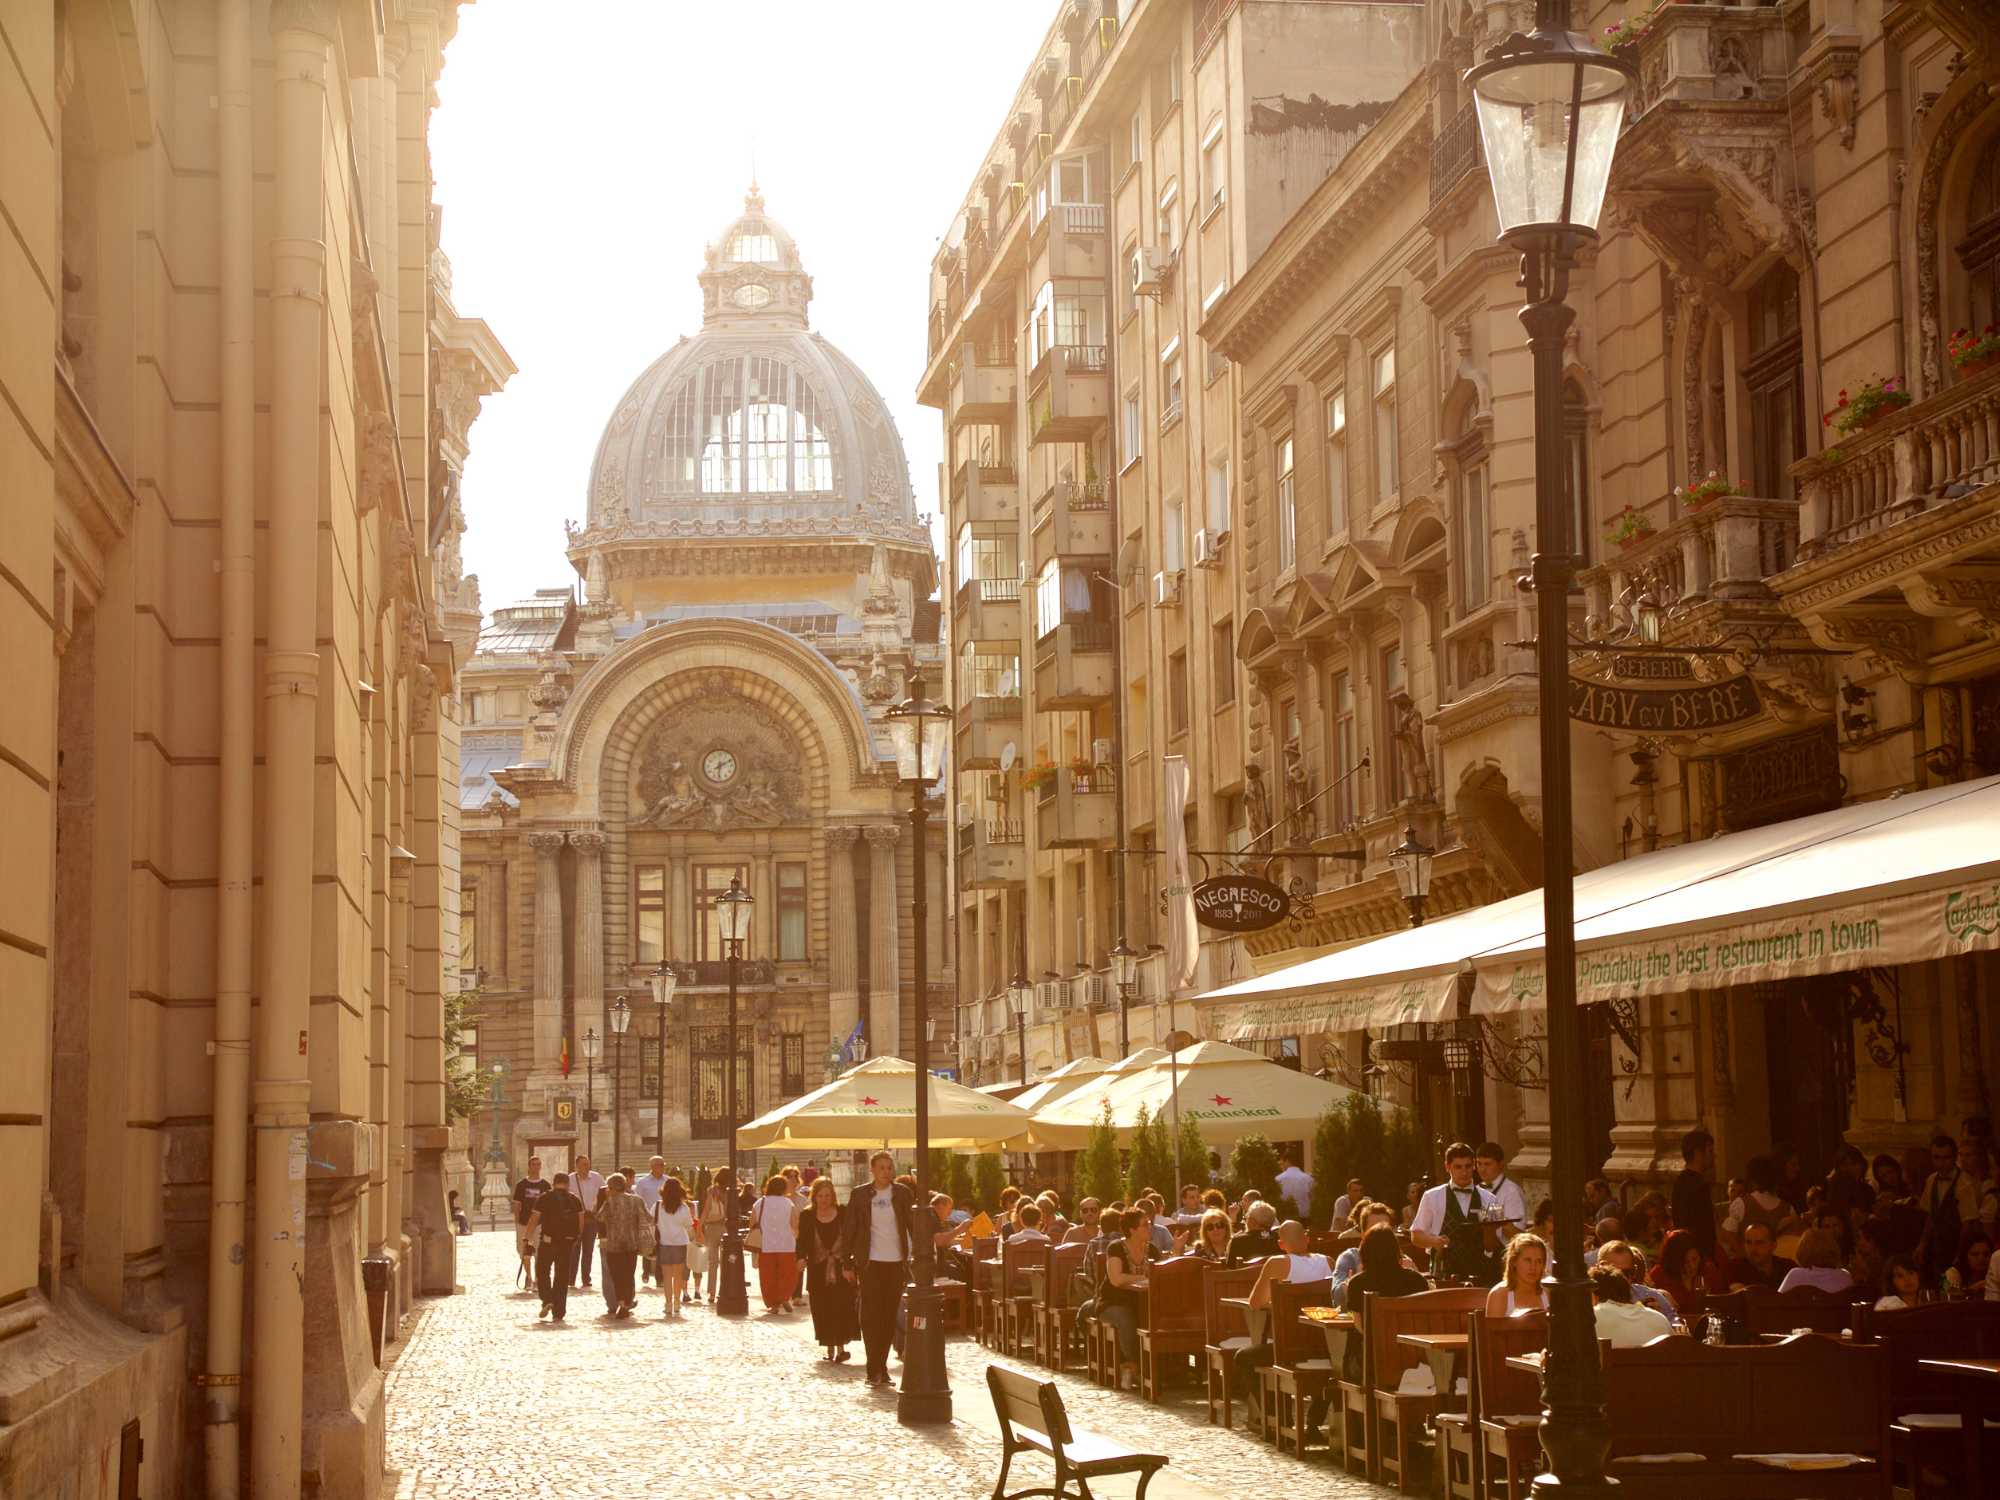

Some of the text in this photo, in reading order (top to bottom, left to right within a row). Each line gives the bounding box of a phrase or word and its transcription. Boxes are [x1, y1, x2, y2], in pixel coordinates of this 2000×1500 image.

[1616, 660, 1690, 678] BERERIE
[1670, 684, 1747, 727] BERE
[1196, 887, 1281, 914] NEGRESCO
[1945, 886, 2000, 938] Carlsber
[1215, 909, 1262, 919] 1883 2011
[1581, 919, 1880, 990] Probably the best restaurant in town
[1512, 964, 1544, 997] Carlsberg
[1288, 1001, 1303, 1022] best
[831, 1107, 917, 1115] Heineken
[1192, 1108, 1282, 1119] Heineken
